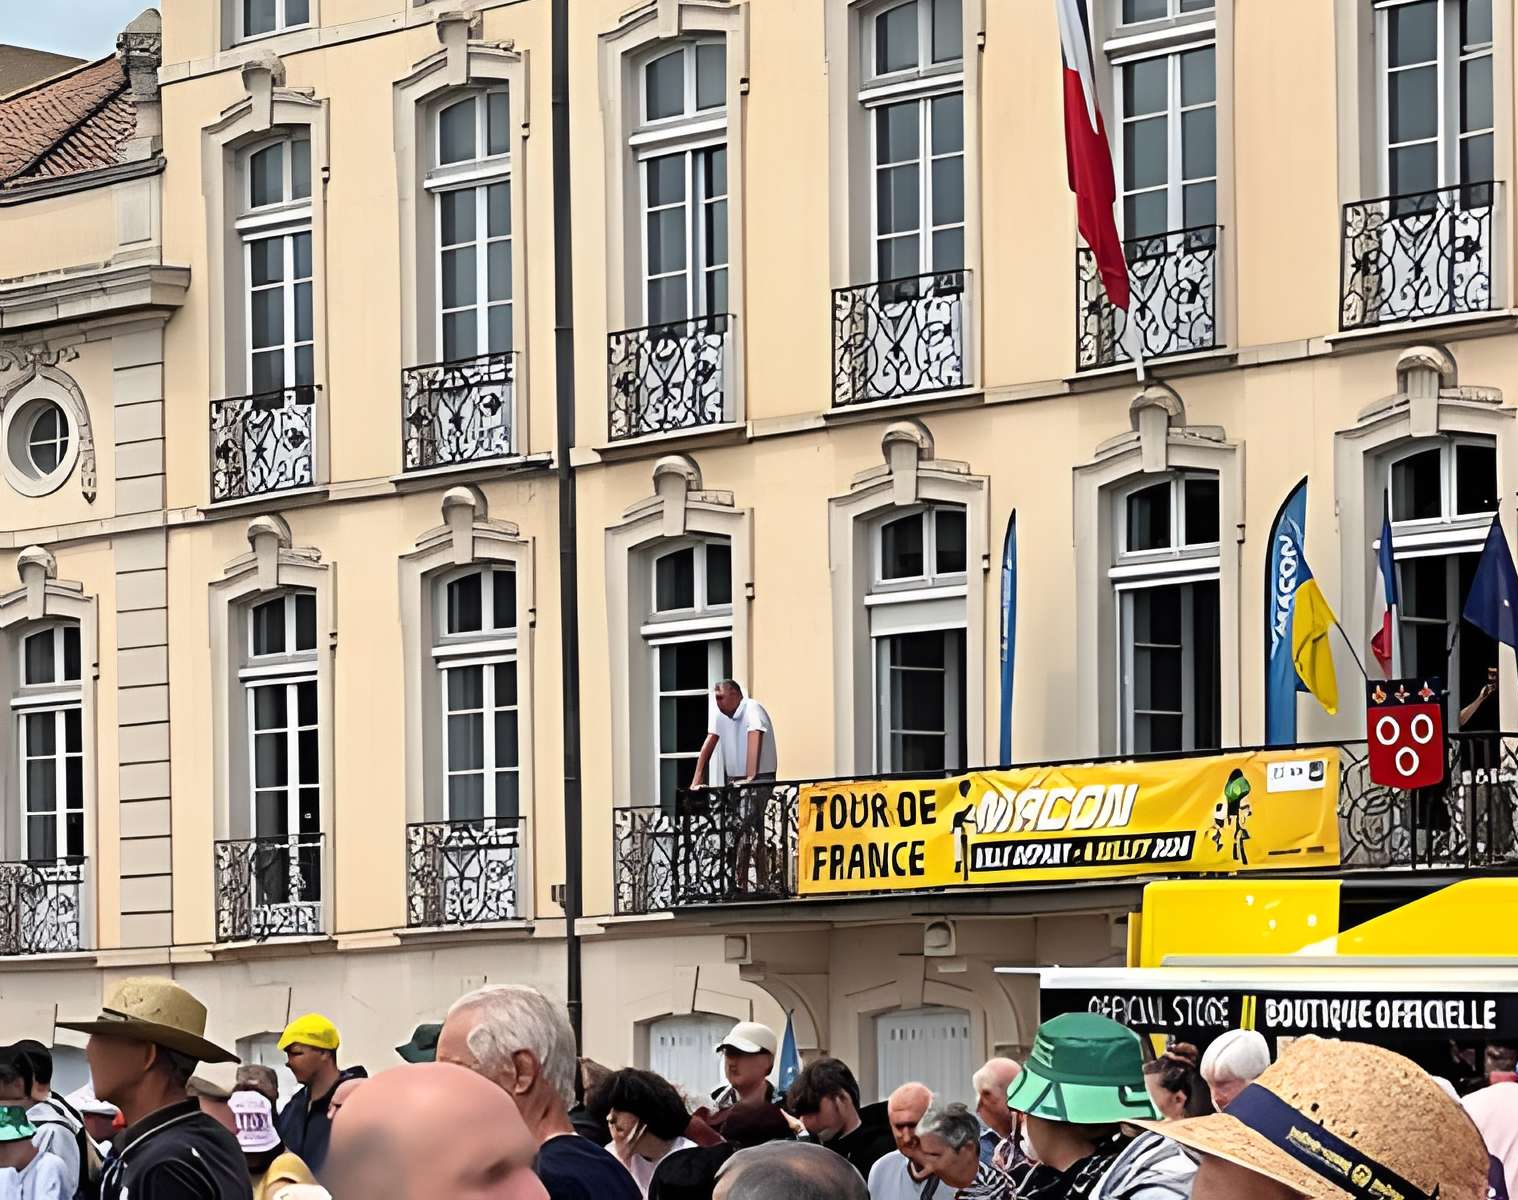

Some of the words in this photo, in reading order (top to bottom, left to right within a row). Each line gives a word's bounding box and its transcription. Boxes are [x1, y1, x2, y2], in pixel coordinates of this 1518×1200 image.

[810, 792, 889, 832] TOUR
[897, 789, 936, 828] DE
[812, 841, 925, 881] FRANCE
[1265, 998, 1372, 1031] BOUTIQUE
